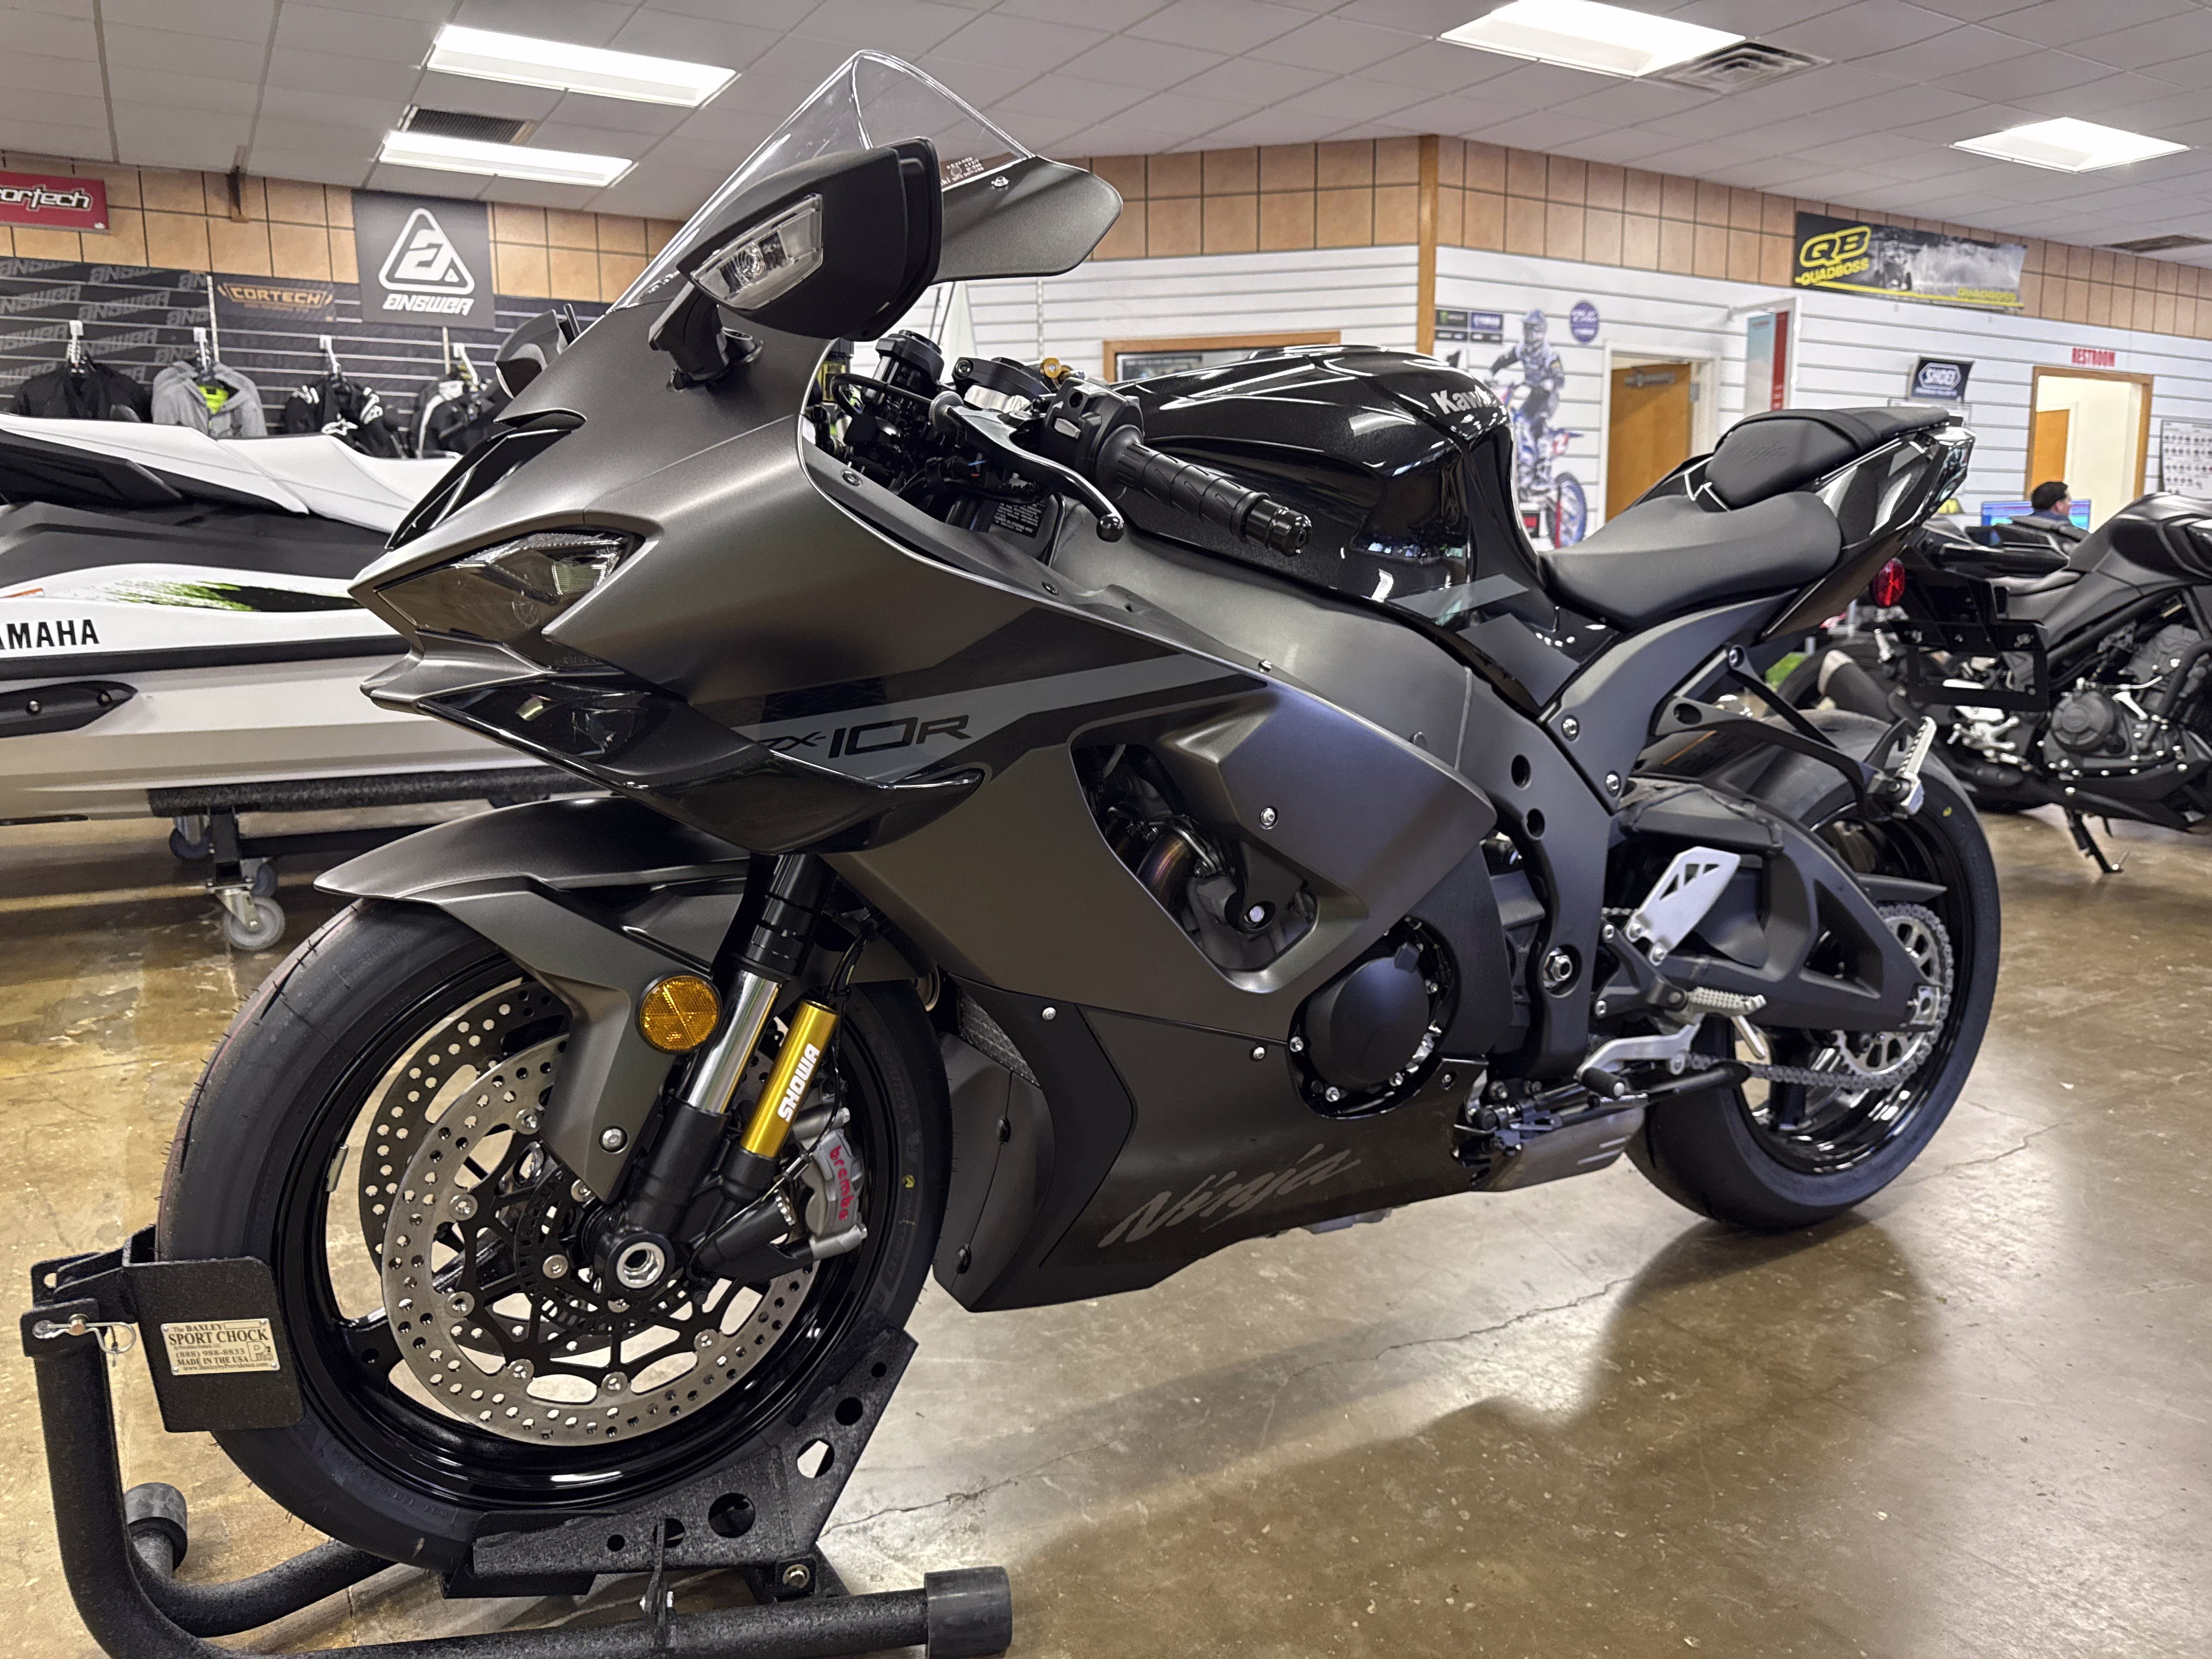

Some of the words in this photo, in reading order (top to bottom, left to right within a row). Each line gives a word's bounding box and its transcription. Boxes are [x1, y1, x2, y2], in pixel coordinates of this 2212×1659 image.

[0, 188, 91, 209] ortech
[229, 287, 321, 305] CORTECH
[382, 294, 475, 316] ANSWER
[758, 715, 972, 759] ZX-10R
[777, 1043, 820, 1122] SHOWA
[829, 1145, 854, 1220] brembo
[1098, 1144, 1361, 1248] Ninja
[168, 1332, 212, 1345] SPORT
[216, 1329, 269, 1342] CHOCK
[186, 1323, 224, 1332] BAXLEY
[202, 1348, 246, 1356] 988-8833
[215, 1356, 231, 1364] THE
[232, 1355, 249, 1363] USA
